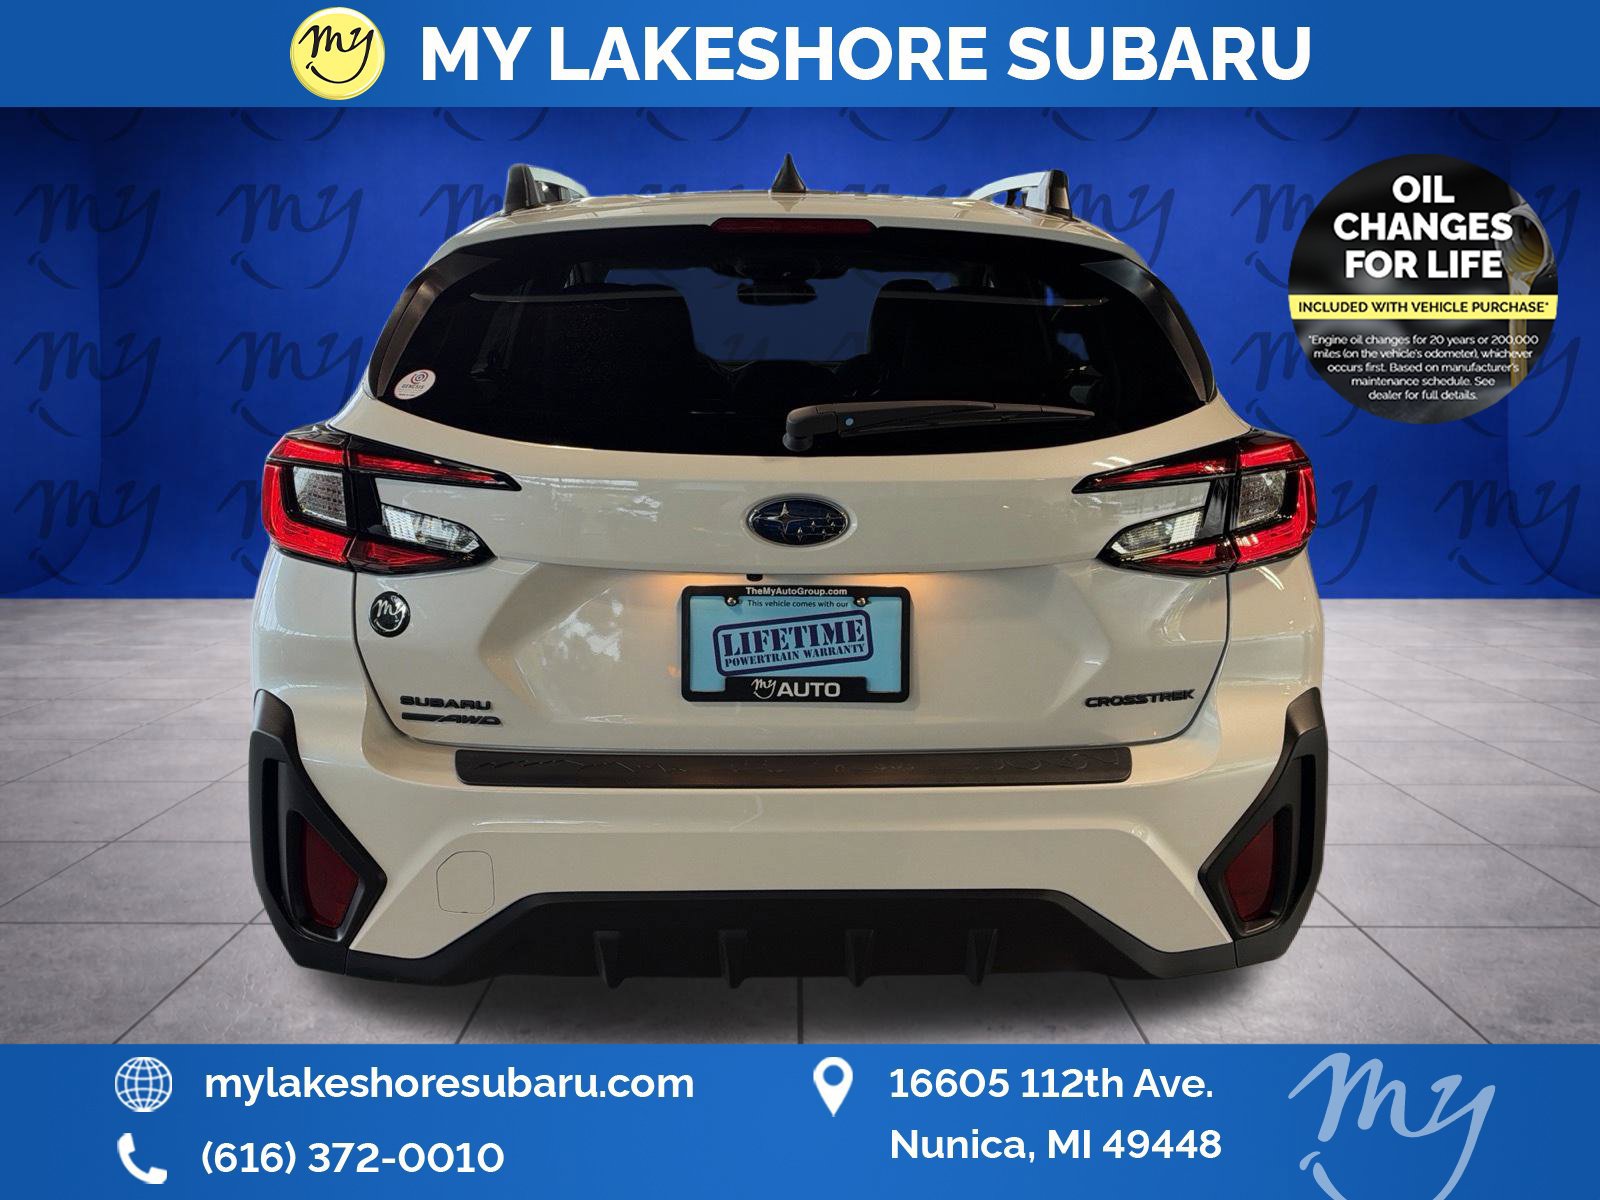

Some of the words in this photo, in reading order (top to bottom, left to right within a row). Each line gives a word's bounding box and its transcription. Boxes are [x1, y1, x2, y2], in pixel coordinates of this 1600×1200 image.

[745, 586, 848, 596] TheMyAutoGroup.com
[818, 600, 835, 608] with
[722, 619, 866, 657] LIFETIME
[724, 651, 800, 668] POWERTRAIN
[804, 643, 866, 659] WARRANTY
[776, 682, 841, 698] AUTO
[400, 695, 491, 710] SUBARU
[1085, 689, 1195, 708] CROSSTREK
[438, 714, 501, 726] AWD
